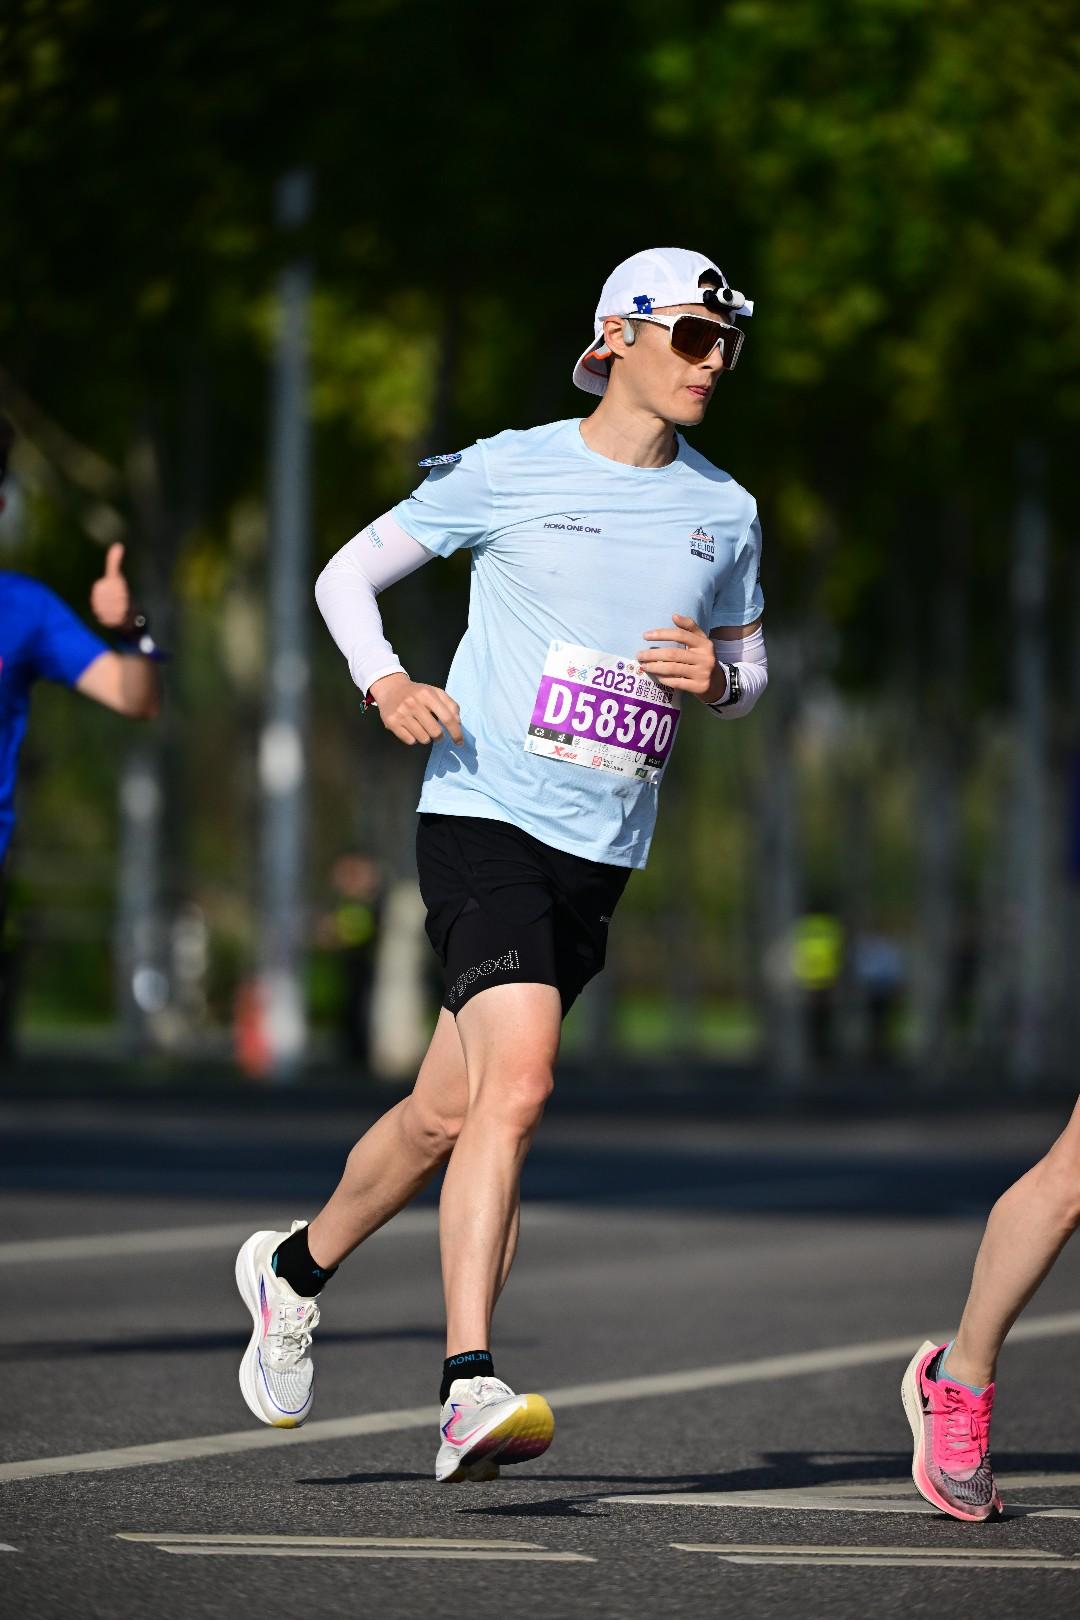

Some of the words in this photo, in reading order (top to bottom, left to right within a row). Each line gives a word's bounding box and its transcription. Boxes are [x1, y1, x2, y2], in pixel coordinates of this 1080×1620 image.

[543, 522, 566, 530] HOKA
[566, 524, 583, 532] ONE
[584, 526, 602, 535] ONE
[592, 667, 636, 693] 2023
[542, 682, 673, 753] D58390
